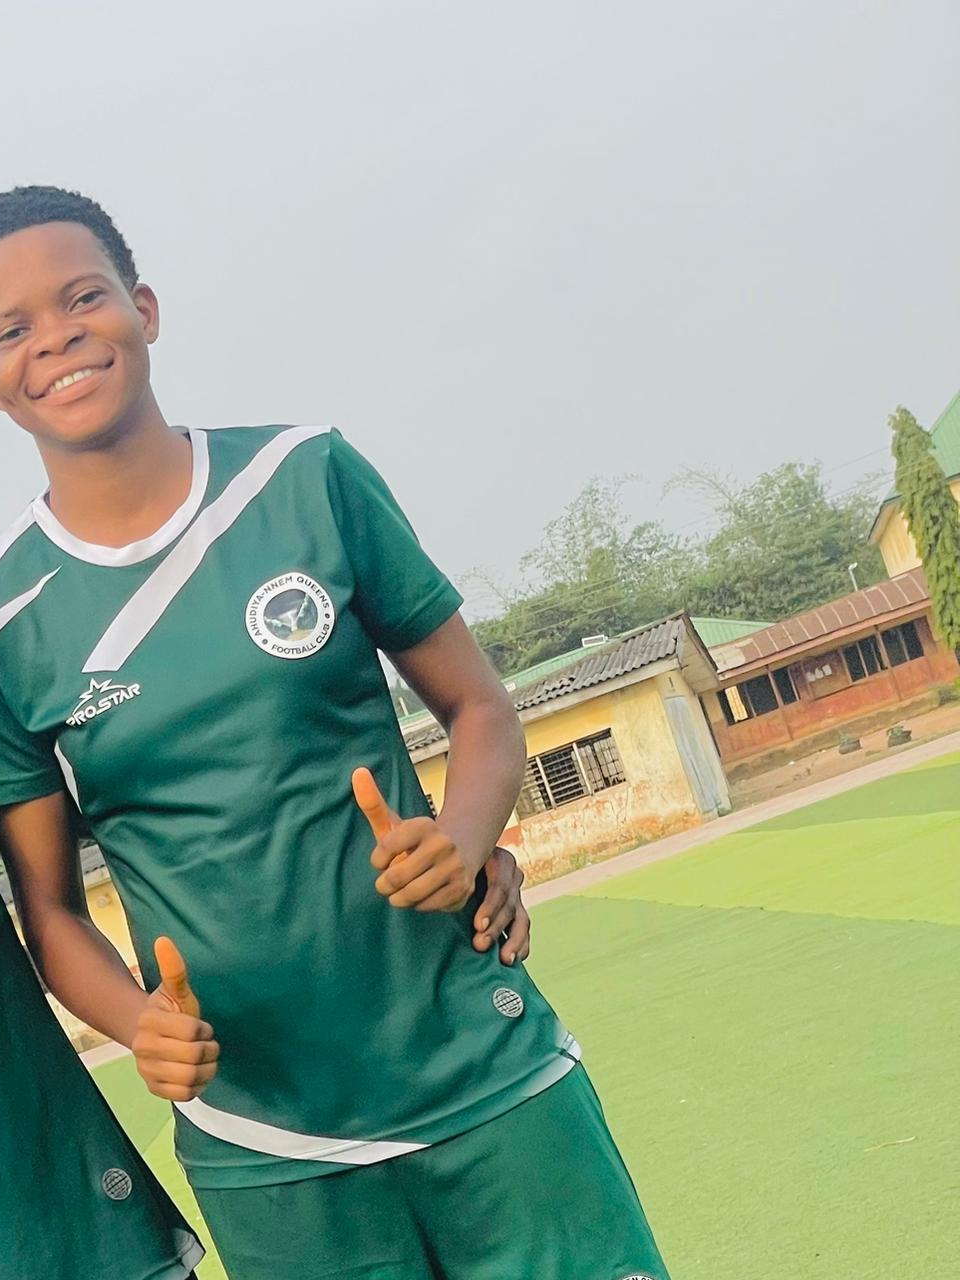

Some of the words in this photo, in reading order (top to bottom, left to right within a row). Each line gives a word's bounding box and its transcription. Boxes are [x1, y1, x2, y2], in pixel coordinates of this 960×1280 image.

[249, 576, 293, 637] AHUDIYA-NNEM
[296, 576, 330, 609] QUEENS
[271, 643, 317, 655] FOOTBALL
[315, 623, 330, 644] CLUB
